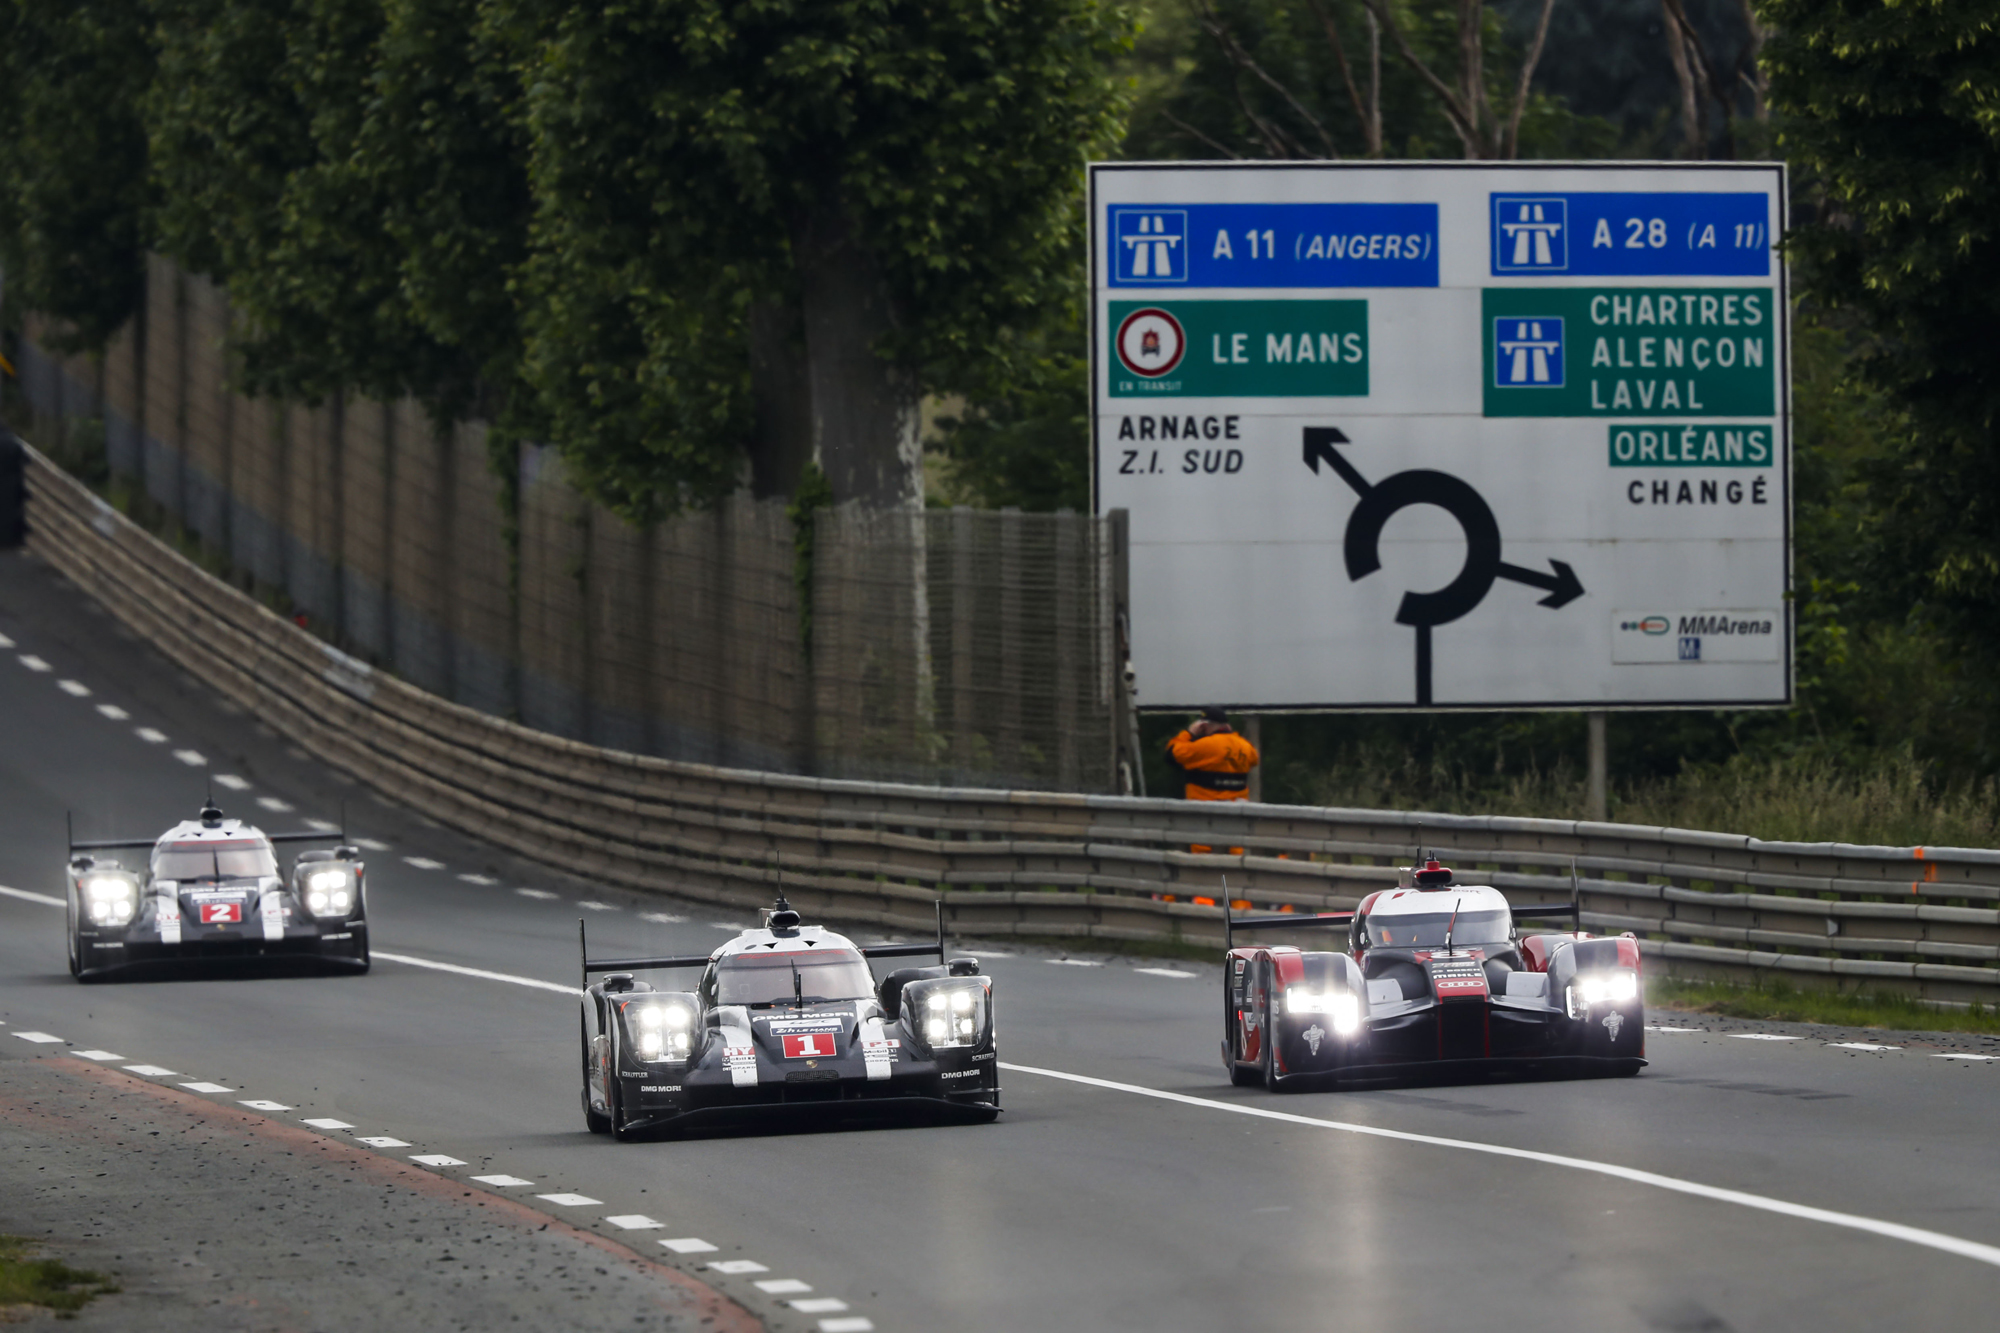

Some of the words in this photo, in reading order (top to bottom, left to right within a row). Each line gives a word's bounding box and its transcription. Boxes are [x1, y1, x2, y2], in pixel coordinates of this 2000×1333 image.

[1212, 230, 1233, 259] A
[1245, 229, 1276, 259] 11
[1294, 233, 1432, 262] (ANGERS)
[1592, 219, 1613, 249] A
[1625, 218, 1668, 248] 28
[1687, 223, 1717, 251] (A
[1733, 222, 1765, 249] 11)
[1590, 295, 1764, 326] CHARTRES
[1212, 335, 1249, 363] LE
[1266, 333, 1364, 364] MANS
[1590, 337, 1765, 371] ALENÇON
[1119, 381, 1134, 391] EN
[1138, 380, 1182, 391] TRANSIT
[1590, 379, 1705, 410] LAVAL
[1118, 415, 1242, 441] ARNAGE
[1614, 424, 1768, 462] ORLÉANS
[1118, 450, 1166, 475] Z.I.
[1182, 449, 1245, 475] SUD
[1627, 475, 1769, 505] CHANGÉ
[1678, 616, 1773, 635] MMArena
[210, 903, 232, 921] 2
[737, 949, 849, 961] PORSCHE
[1432, 972, 1483, 980] MAHLE
[752, 1013, 799, 1023] DMG
[801, 1011, 855, 1019] MORI
[723, 1047, 754, 1056] HY
[797, 1035, 821, 1056] 1
[941, 1071, 962, 1079] DMG
[963, 1069, 980, 1077] MORI
